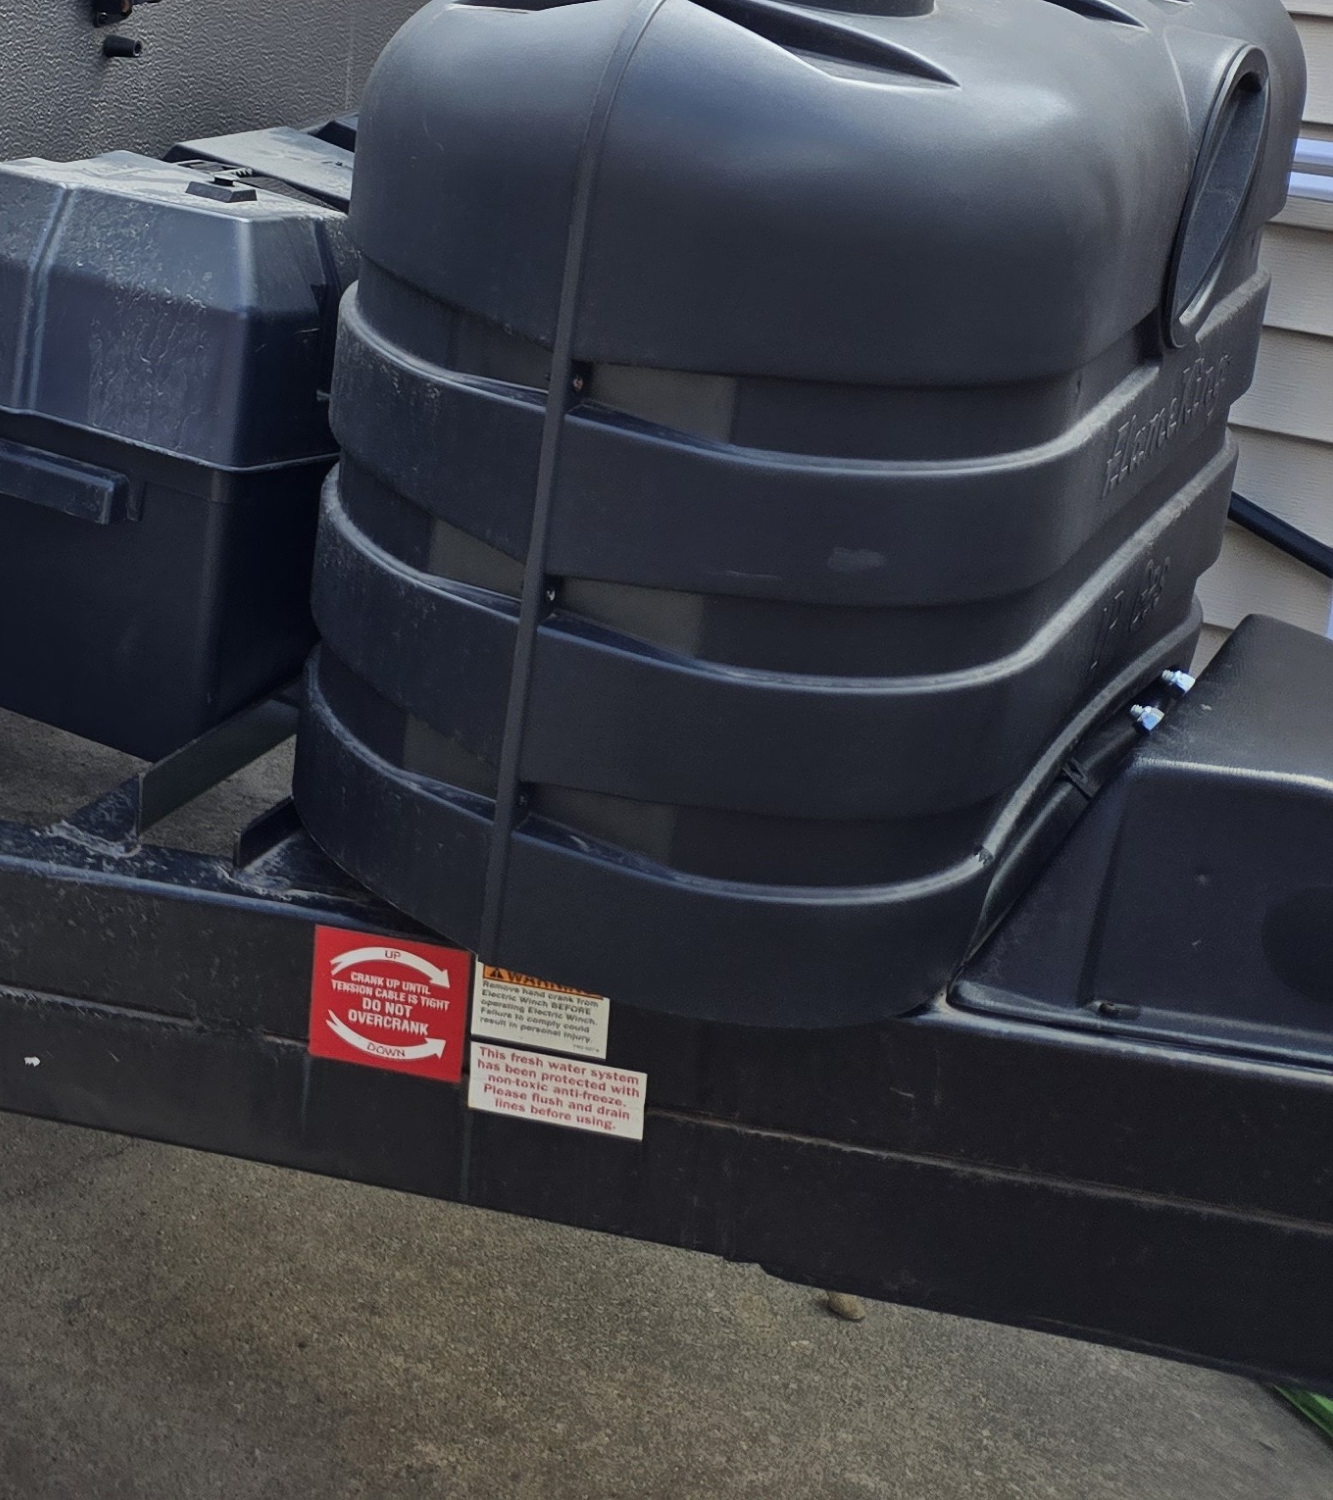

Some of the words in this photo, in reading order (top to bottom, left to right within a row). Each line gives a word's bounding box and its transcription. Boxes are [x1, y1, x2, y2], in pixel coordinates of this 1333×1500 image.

[384, 949, 401, 960] UP
[350, 971, 384, 986] CRANK
[386, 978, 400, 988] UP
[402, 981, 431, 995] UNTIL
[483, 981, 520, 993] Remove
[522, 988, 545, 999] hand
[332, 979, 373, 996] TENSION
[375, 987, 405, 1002] CABLE
[407, 994, 417, 1005] IS
[421, 996, 450, 1011] TIGHT
[482, 989, 516, 1001] Electric
[519, 997, 548, 1007] Winch
[552, 1003, 591, 1015] BEFORE
[362, 997, 381, 1013] DO
[385, 1001, 413, 1018] NOT
[481, 999, 525, 1014] operating
[528, 1007, 563, 1020] Electric
[481, 1006, 512, 1019] Failure
[527, 1016, 561, 1029] comply
[348, 1009, 429, 1036] OVERCRANK
[520, 1024, 560, 1037] personal
[367, 1042, 405, 1057] DOWN
[477, 1058, 500, 1071] has
[504, 1063, 536, 1077] been
[541, 1070, 605, 1092] protected
[610, 1083, 639, 1096] with
[479, 1046, 506, 1060] This
[510, 1052, 543, 1067] fresh
[547, 1058, 586, 1074] water
[590, 1066, 639, 1086] system
[487, 1072, 547, 1093] non-toxic
[483, 1082, 527, 1100] Please
[531, 1091, 563, 1107] flush
[567, 1098, 592, 1112] and
[596, 1103, 629, 1119] drain
[494, 1097, 525, 1112] lines
[530, 1104, 571, 1120] before
[576, 1112, 616, 1131] using.
